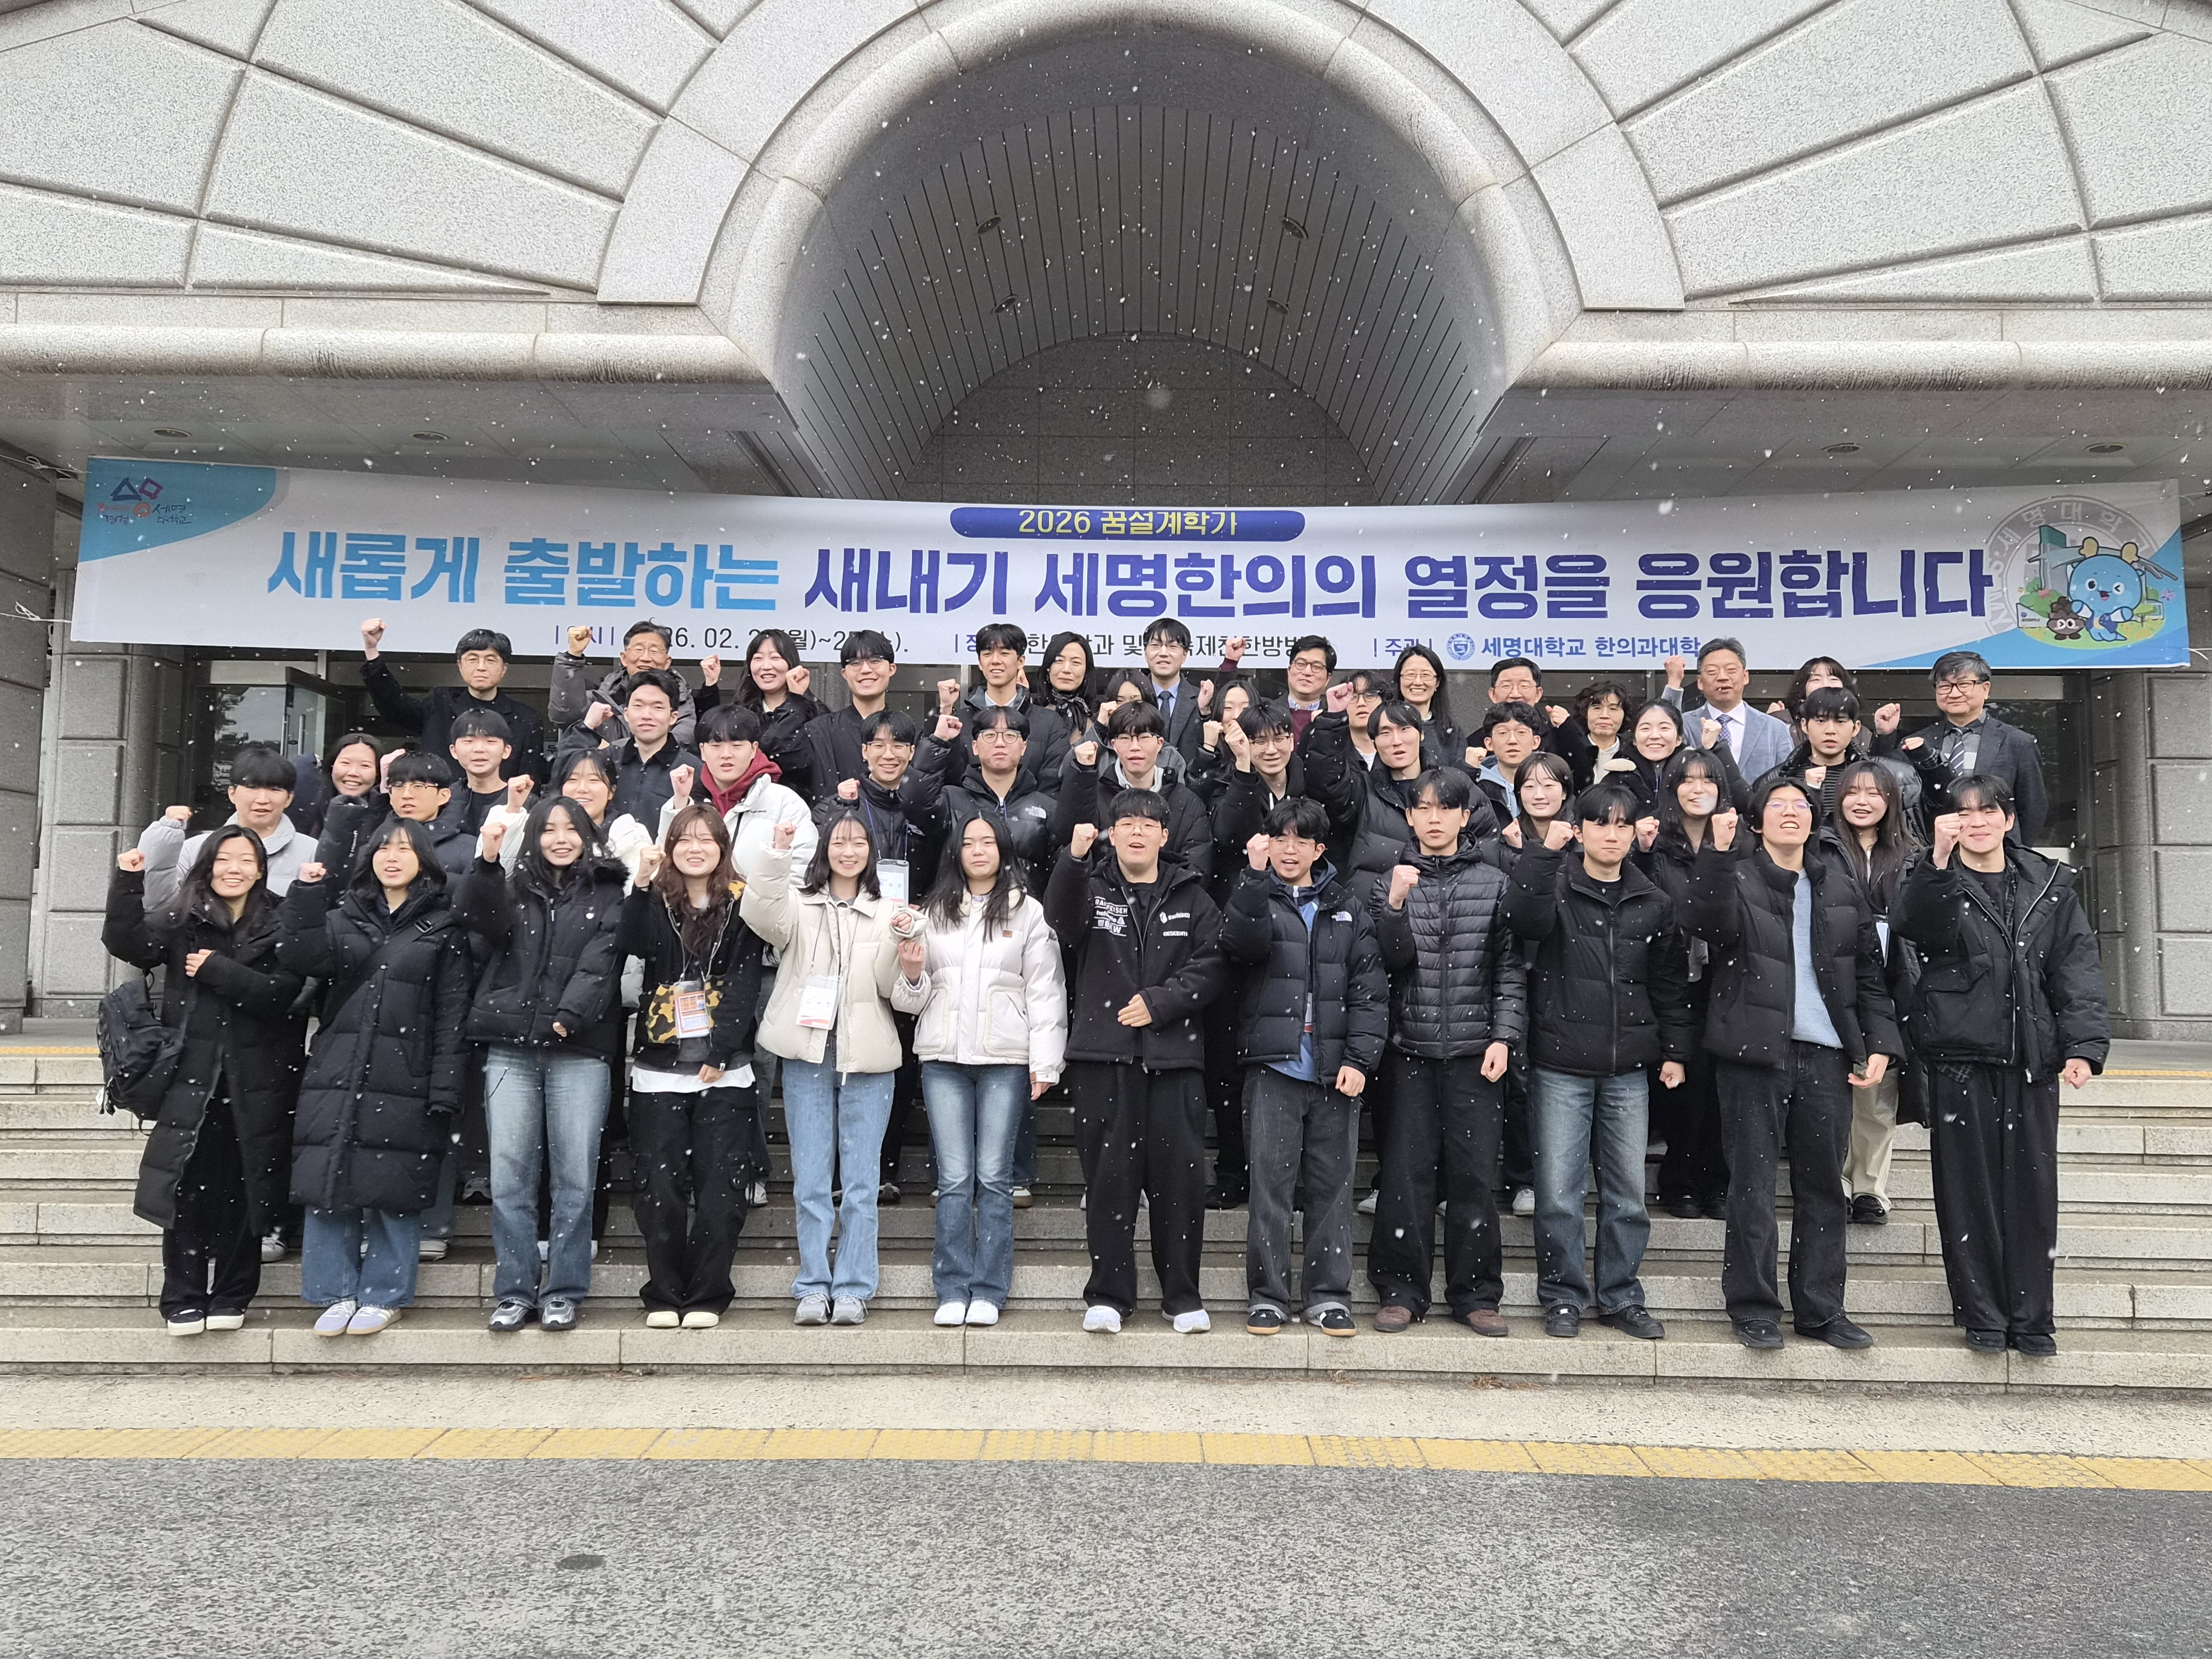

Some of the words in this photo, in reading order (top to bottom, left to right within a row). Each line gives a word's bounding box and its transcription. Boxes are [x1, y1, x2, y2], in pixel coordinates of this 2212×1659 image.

[1019, 510, 1091, 534] 2026
[1101, 510, 1236, 535] 꿈설계학기
[268, 531, 479, 603] 새롭게
[504, 538, 779, 611] 출발하는
[805, 548, 1008, 615] 새내기
[1035, 552, 1376, 619] 세명한의의
[1405, 554, 1610, 619] 열정을
[1636, 550, 1994, 619] 응원합니다
[705, 628, 739, 648] 02.
[1123, 634, 1144, 656] 및
[1481, 637, 1587, 658] 세명대학교
[1594, 637, 1701, 658] 한의과대학
